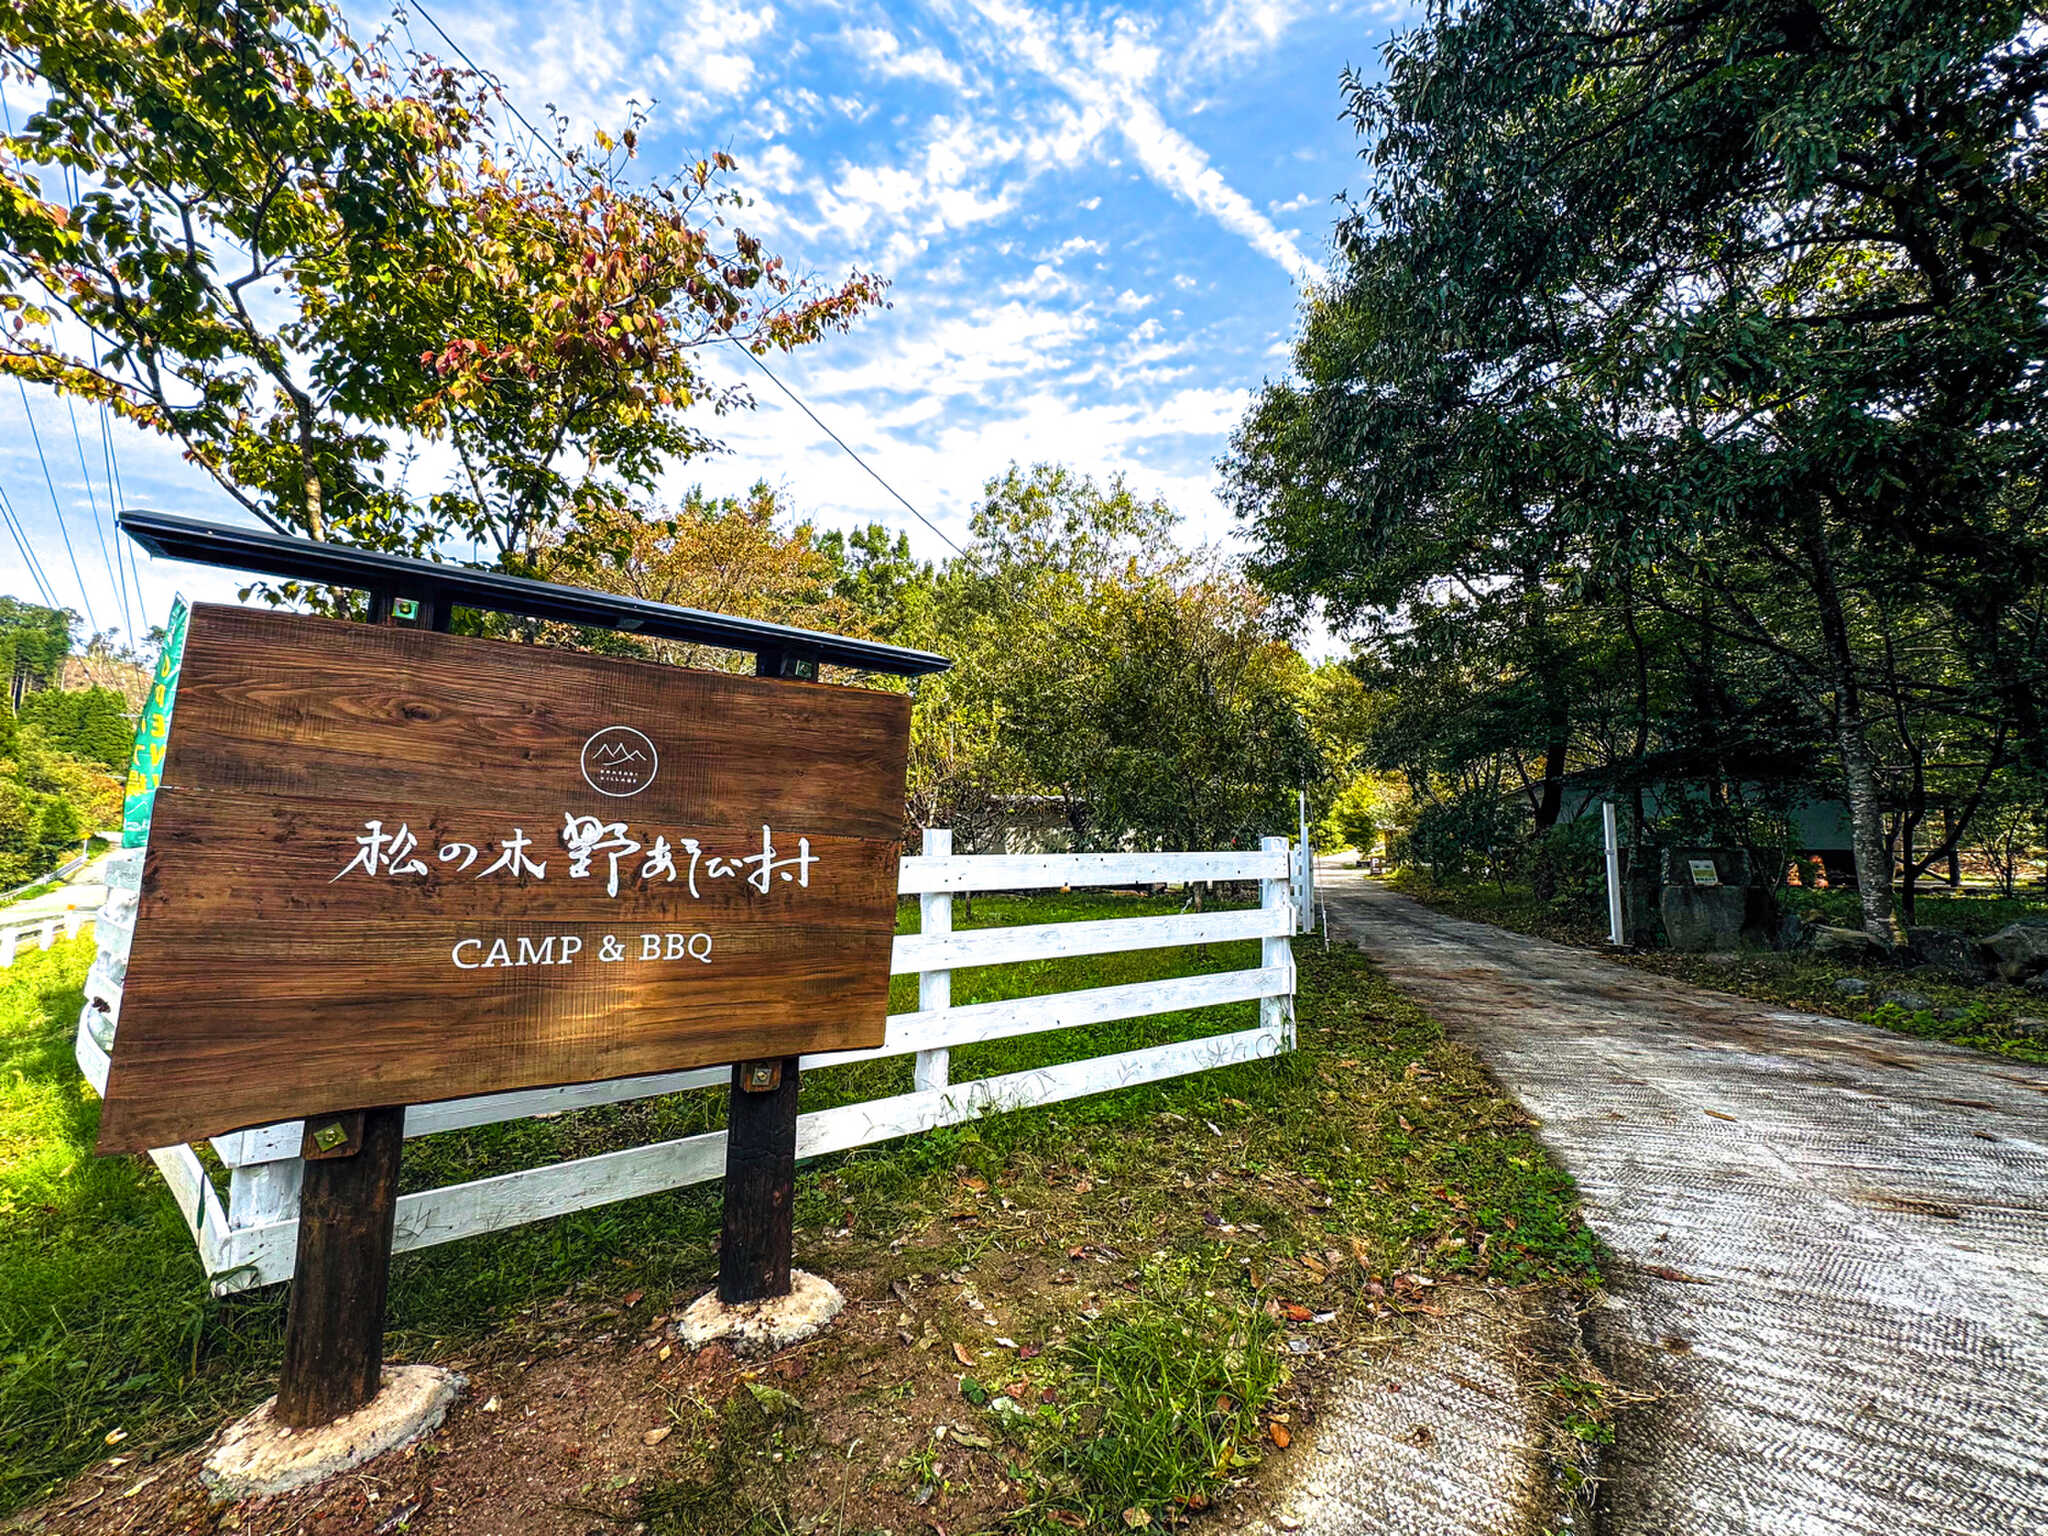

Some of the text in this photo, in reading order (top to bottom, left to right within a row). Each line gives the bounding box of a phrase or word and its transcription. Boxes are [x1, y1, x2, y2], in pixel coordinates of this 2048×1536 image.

[451, 933, 713, 969] CAMP & BBQ
